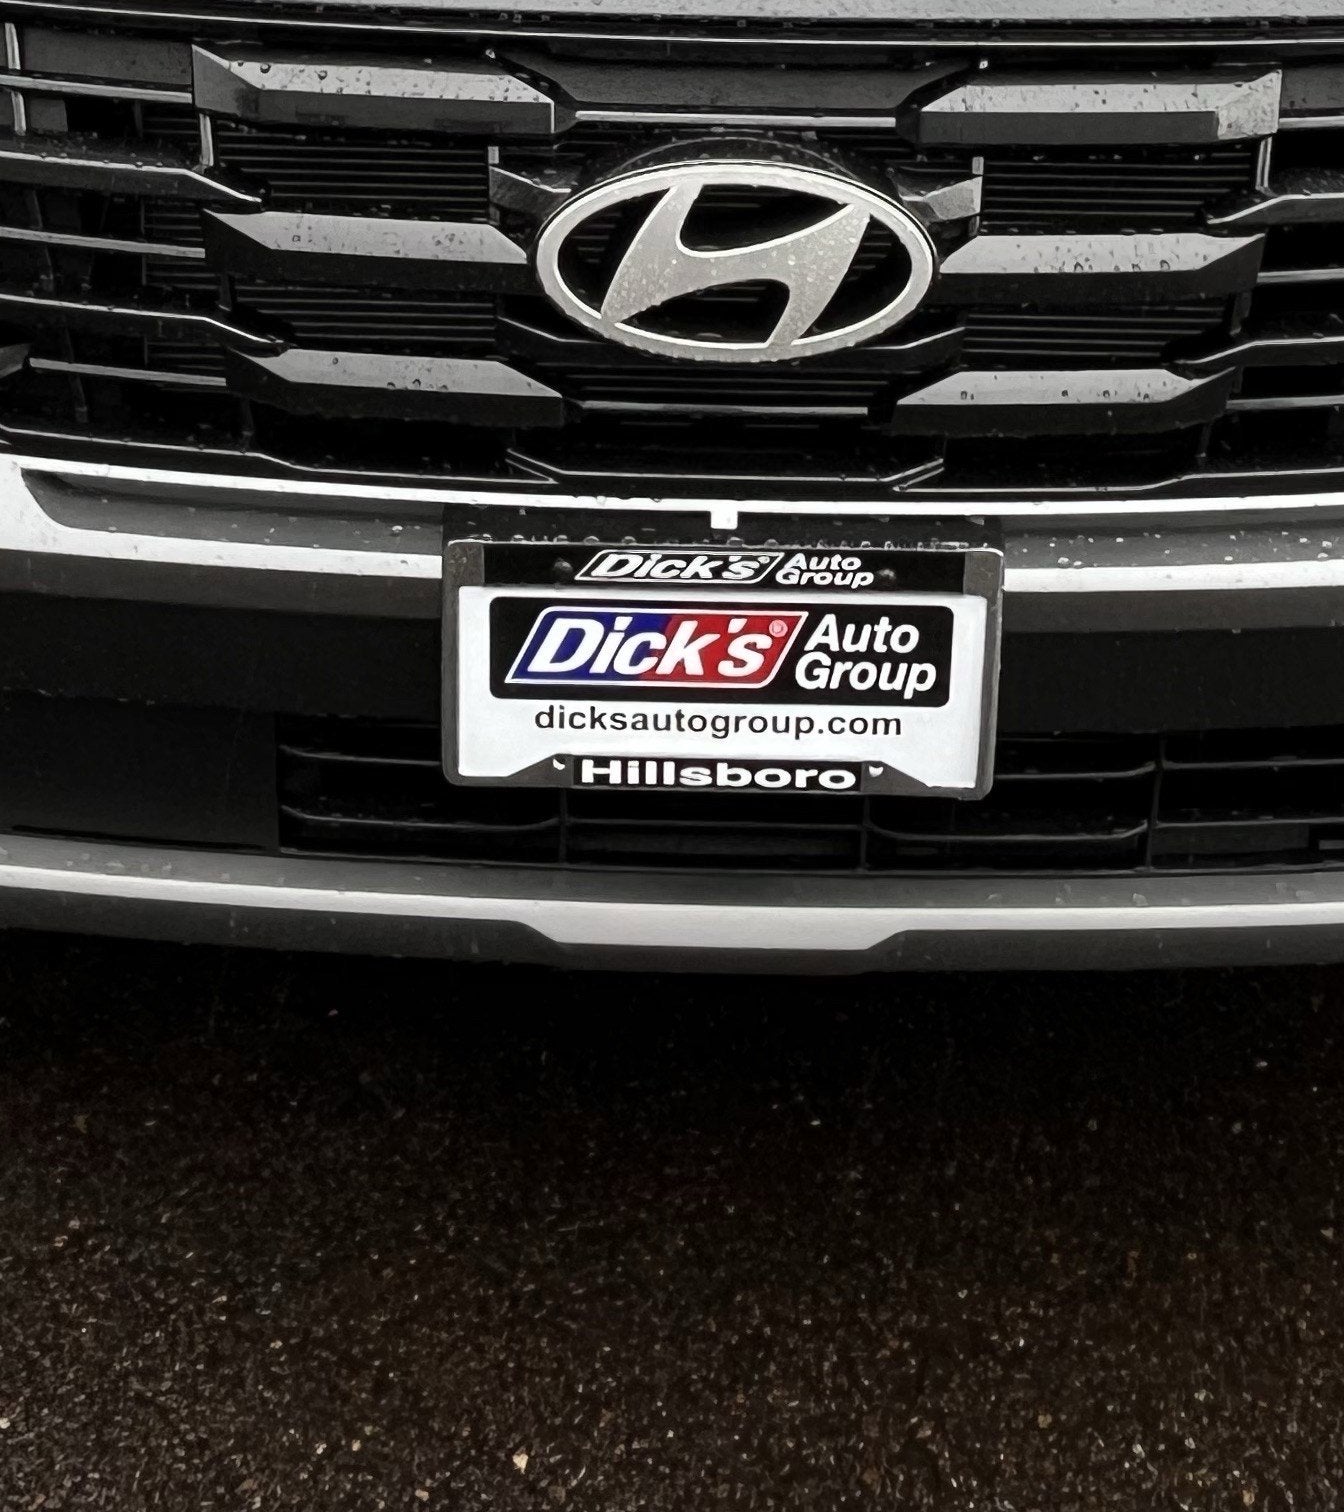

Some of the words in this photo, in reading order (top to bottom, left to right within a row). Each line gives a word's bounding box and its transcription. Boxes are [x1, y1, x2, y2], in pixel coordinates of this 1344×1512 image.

[591, 553, 761, 579] Dick's
[775, 568, 875, 588] Group
[785, 553, 862, 571] Auto
[527, 617, 773, 676] Dick's
[804, 613, 920, 654] Auto
[795, 652, 937, 699] Group
[535, 705, 902, 740] dicksautogroup.com
[581, 758, 857, 789] Hillsboro
